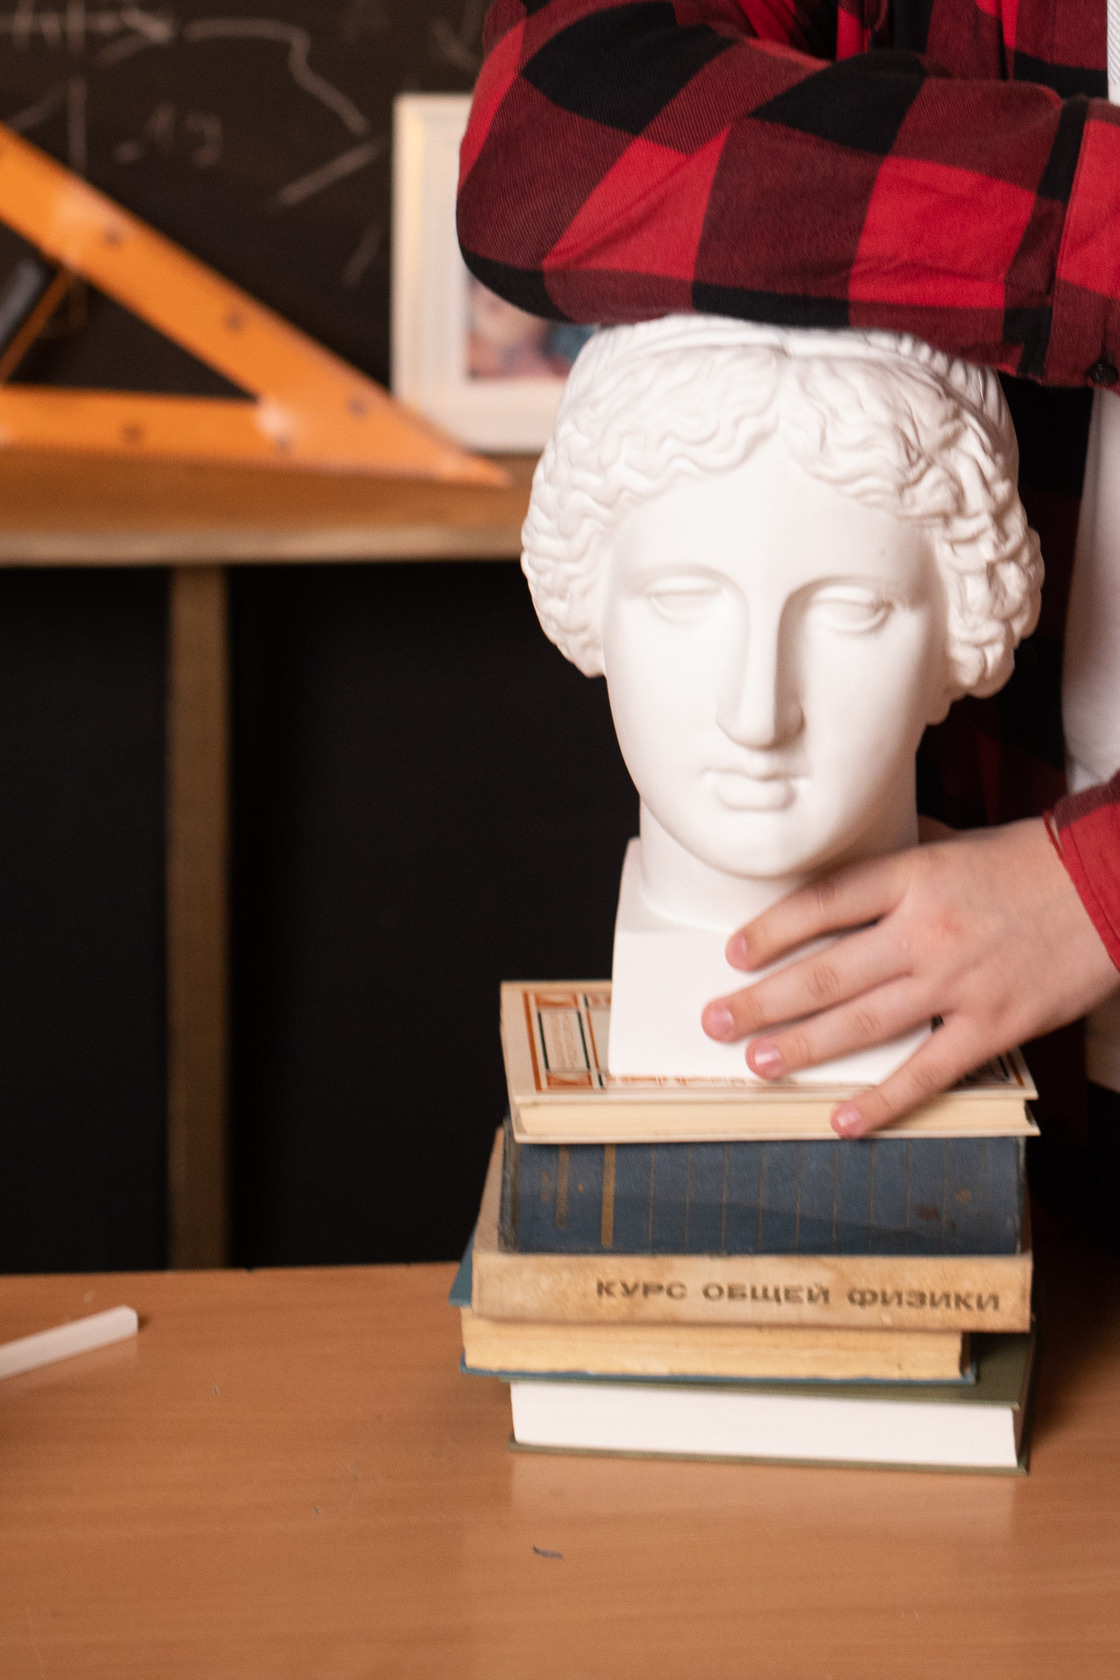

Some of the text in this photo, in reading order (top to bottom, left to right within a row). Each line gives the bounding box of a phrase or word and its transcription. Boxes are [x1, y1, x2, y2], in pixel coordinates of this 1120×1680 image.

[595, 1279, 1000, 1313] КУРС ОБЩЕЙ ФИЗИКИ
